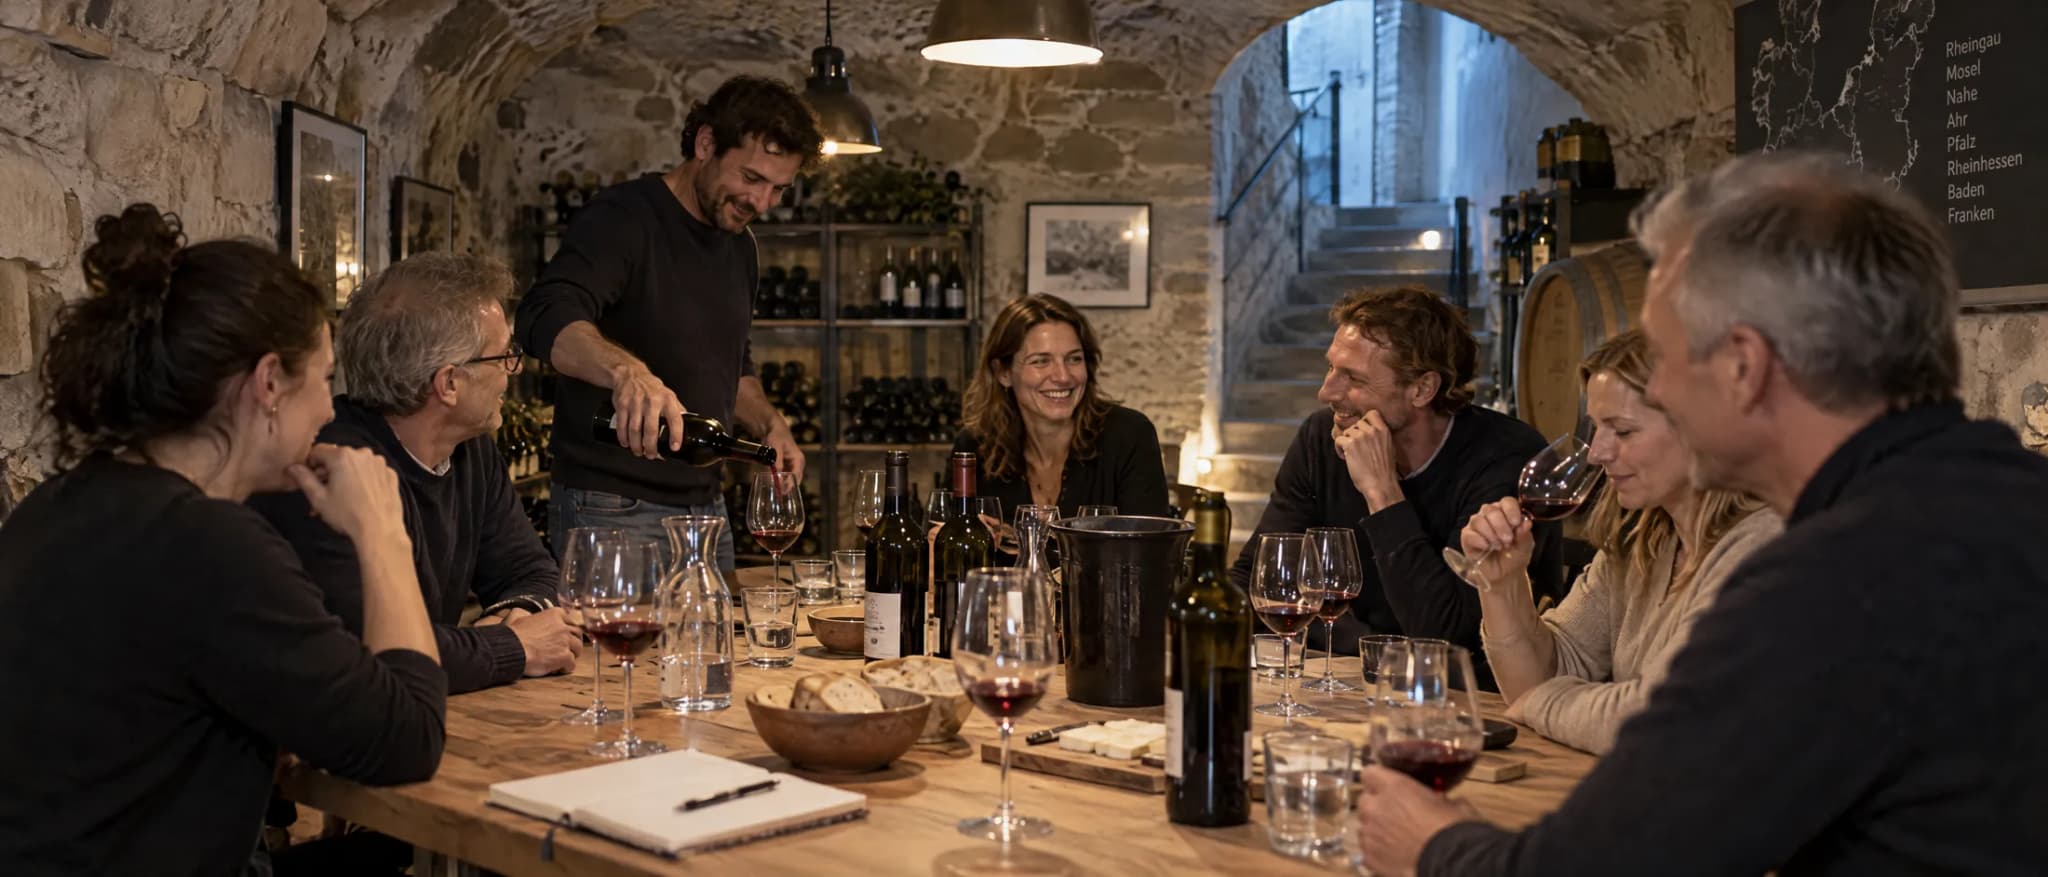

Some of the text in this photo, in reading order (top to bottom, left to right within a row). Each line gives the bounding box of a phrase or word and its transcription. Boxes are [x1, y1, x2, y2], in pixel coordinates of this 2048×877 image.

[1946, 33, 2001, 57] Rheingau
[1947, 59, 1981, 82] Mosel
[1947, 86, 1978, 105] Nahe
[1947, 112, 1969, 129] Ahr
[1947, 134, 1977, 152] Pfalz
[1947, 154, 2023, 177] Rheinhessen
[1948, 182, 1985, 200] Baden
[1948, 205, 1995, 225] Franken
